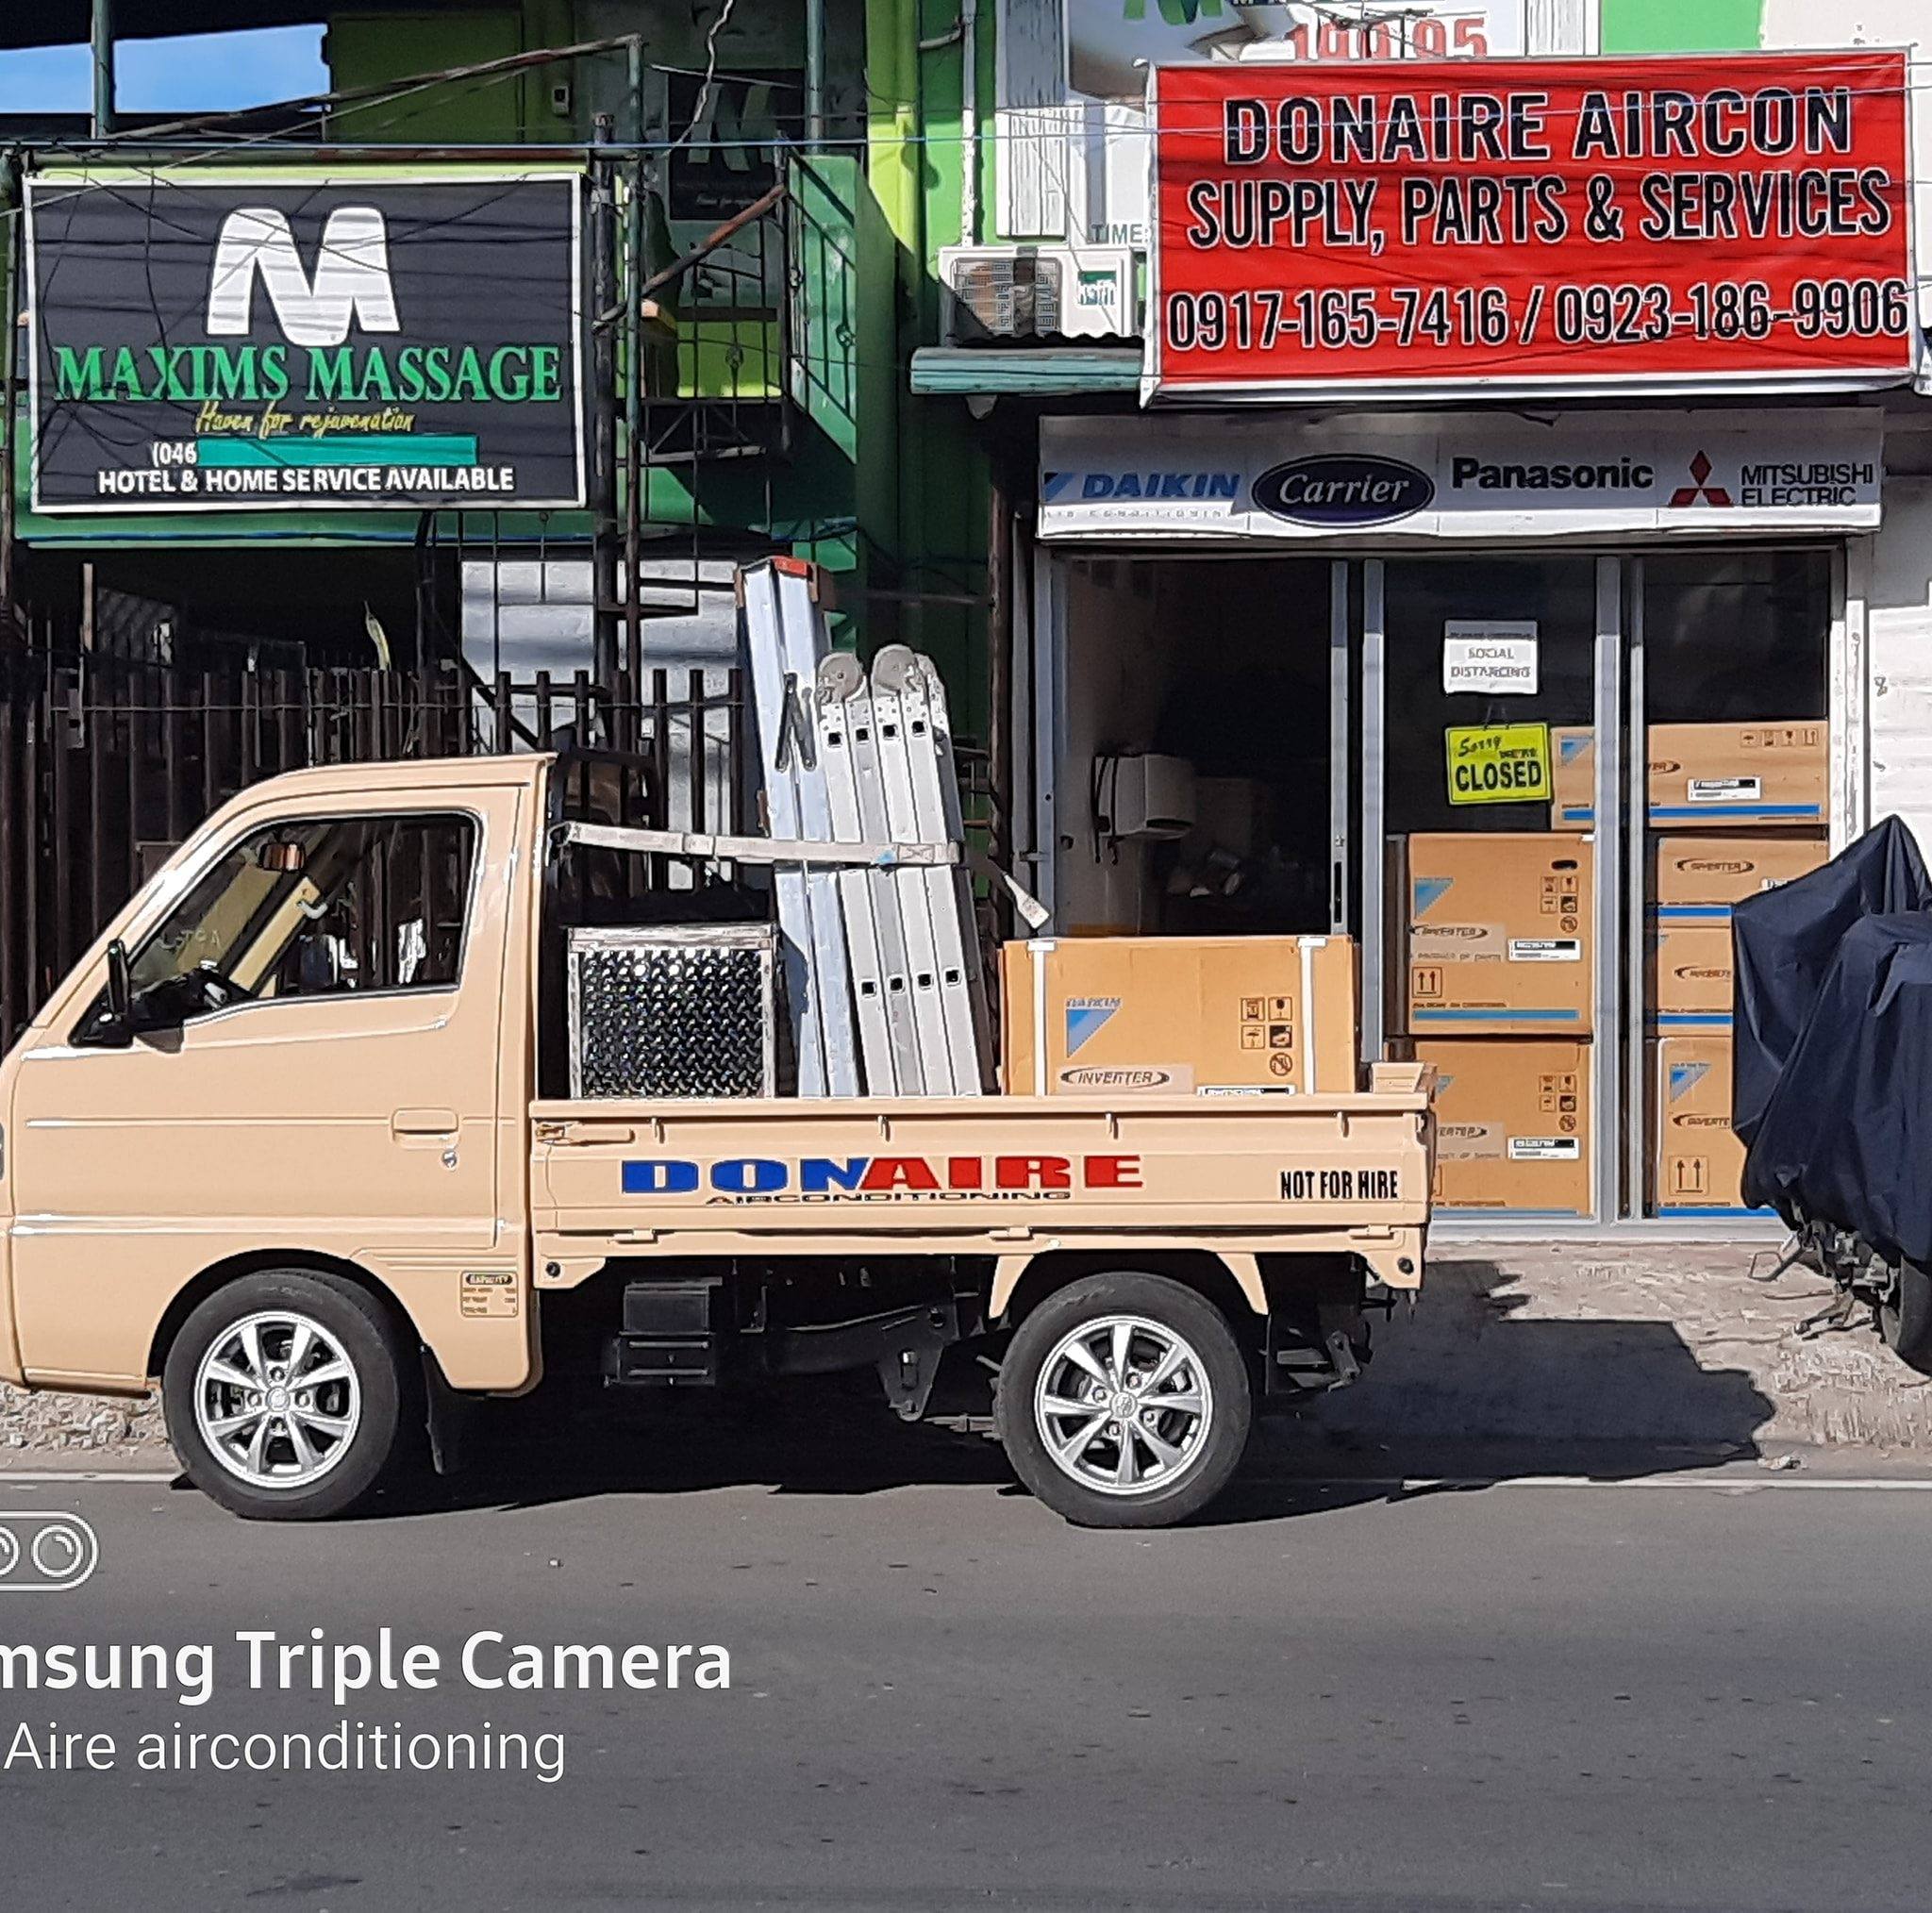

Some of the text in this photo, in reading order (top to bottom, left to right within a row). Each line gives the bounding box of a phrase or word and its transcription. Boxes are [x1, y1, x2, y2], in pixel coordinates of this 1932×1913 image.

[1224, 86, 1850, 165] DONAIRE AIRCON
[1187, 167, 1891, 256] SUPPLY, PARTS & SERVICES
[1167, 286, 1508, 350] 0917-165-7416
[1555, 278, 1908, 343] 0923-186-9906
[53, 345, 562, 402] MAXIMS MASSAGE
[195, 400, 416, 441] Haven for rejuvenation
[98, 468, 515, 493] HOTEL & HOME SERVICE AVAILABLE
[1081, 473, 1241, 499] DAIKIN
[1451, 457, 1655, 490] Panasonic
[1740, 463, 1874, 487] MITSUBISHI
[1279, 474, 1409, 505] Carrier
[1740, 486, 1857, 506] ELECTRIC
[1468, 647, 1515, 659] SOCIAL
[1450, 666, 1531, 678] DISTANCING
[1455, 760, 1542, 792] CLOSED
[1077, 1070, 1154, 1085] INVERTER
[622, 1156, 1144, 1194] DONAIRE
[1280, 1170, 1398, 1200] NOT FOR HIRE
[705, 1191, 1073, 1205] AIRCONDITIONING
